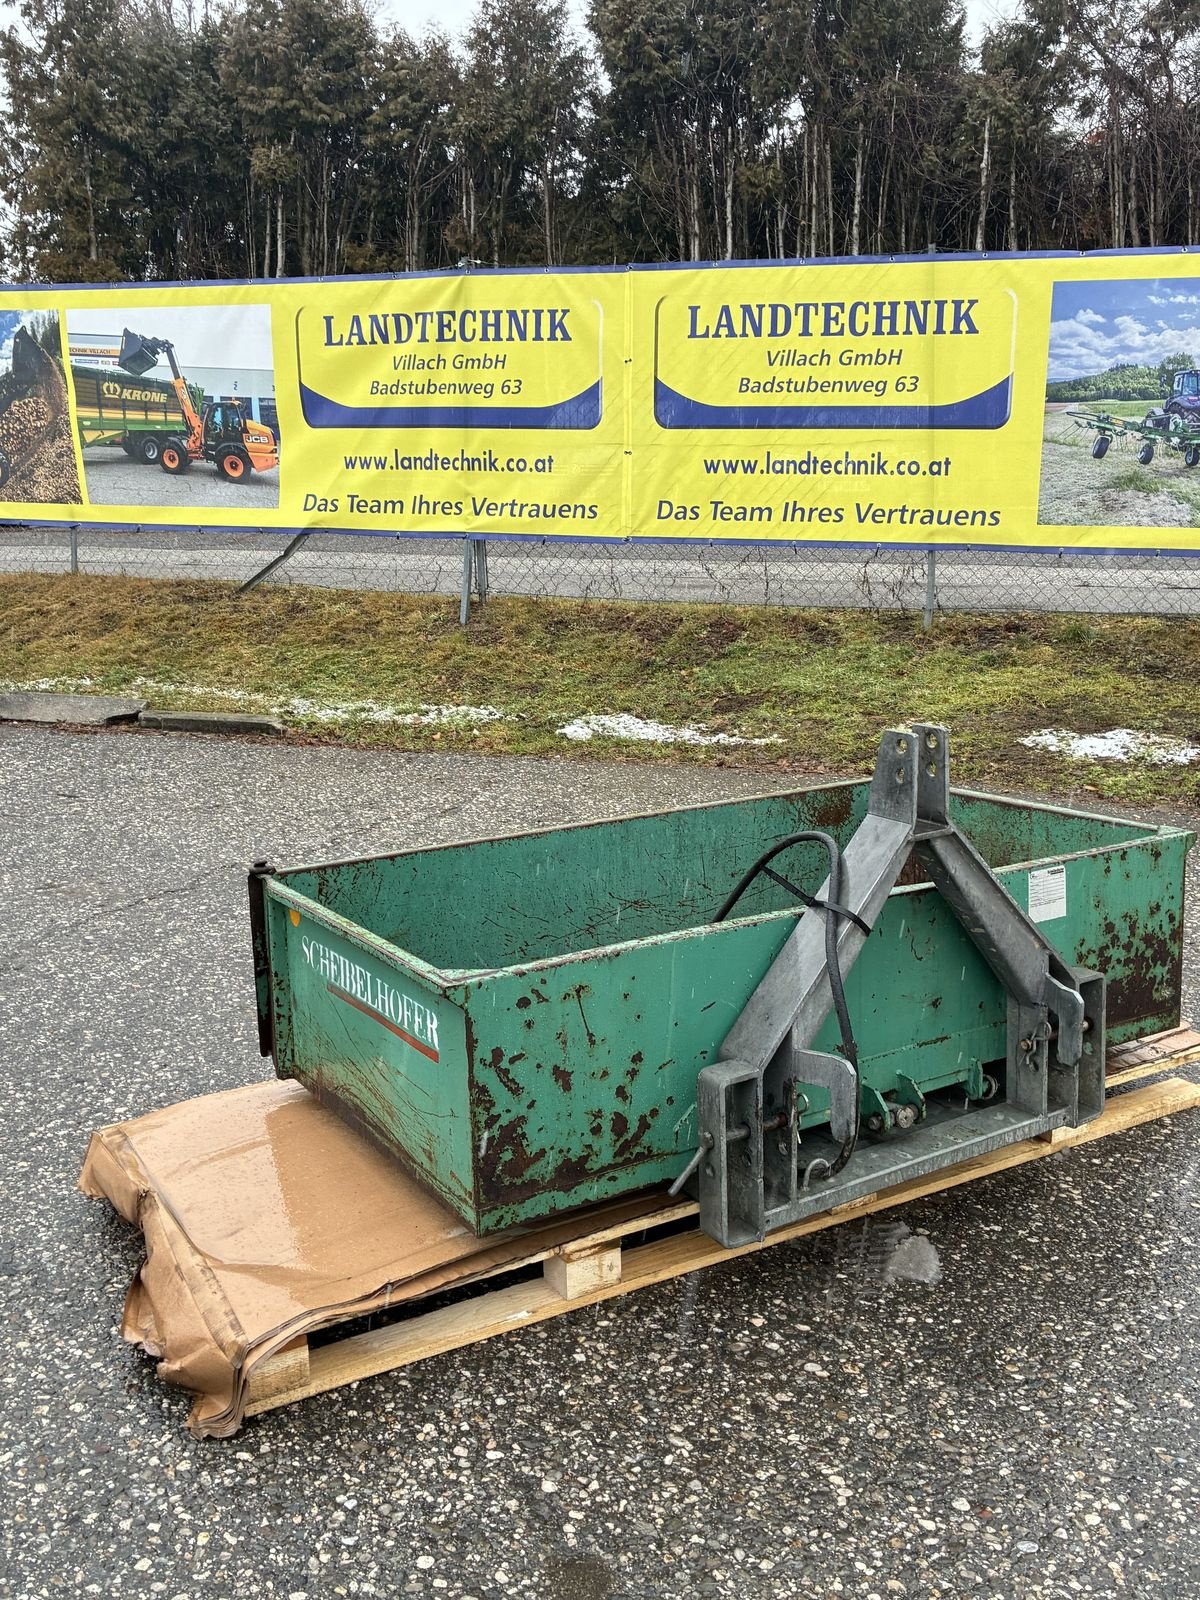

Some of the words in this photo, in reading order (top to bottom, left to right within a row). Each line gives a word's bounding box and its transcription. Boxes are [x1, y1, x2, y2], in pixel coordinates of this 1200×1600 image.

[322, 308, 573, 347] LANDTECHNIK
[688, 299, 980, 339] LANDTECHNIK
[392, 353, 447, 371] Villach
[452, 353, 507, 370] GmbH
[766, 348, 831, 367] Villach
[838, 348, 903, 366] GmbH
[121, 388, 168, 403] KRONE
[370, 378, 495, 399] Badstubenweg
[500, 379, 523, 395] 63
[738, 375, 888, 398] Badstubenweg
[894, 375, 920, 393] 63
[246, 435, 269, 444] JCB
[343, 448, 554, 473] www.landtechnik.co.at
[703, 450, 952, 477] www.landtechnik.co.at
[303, 493, 339, 514] Das
[347, 494, 404, 515] Team
[411, 494, 464, 516] Ihres
[471, 496, 599, 520] Vertrauens
[656, 499, 701, 521] Das
[709, 500, 773, 522] Team
[782, 500, 845, 523] Ihres
[855, 502, 1001, 527] Vertrauens
[301, 936, 440, 1050] SCHEIBELHOFER
